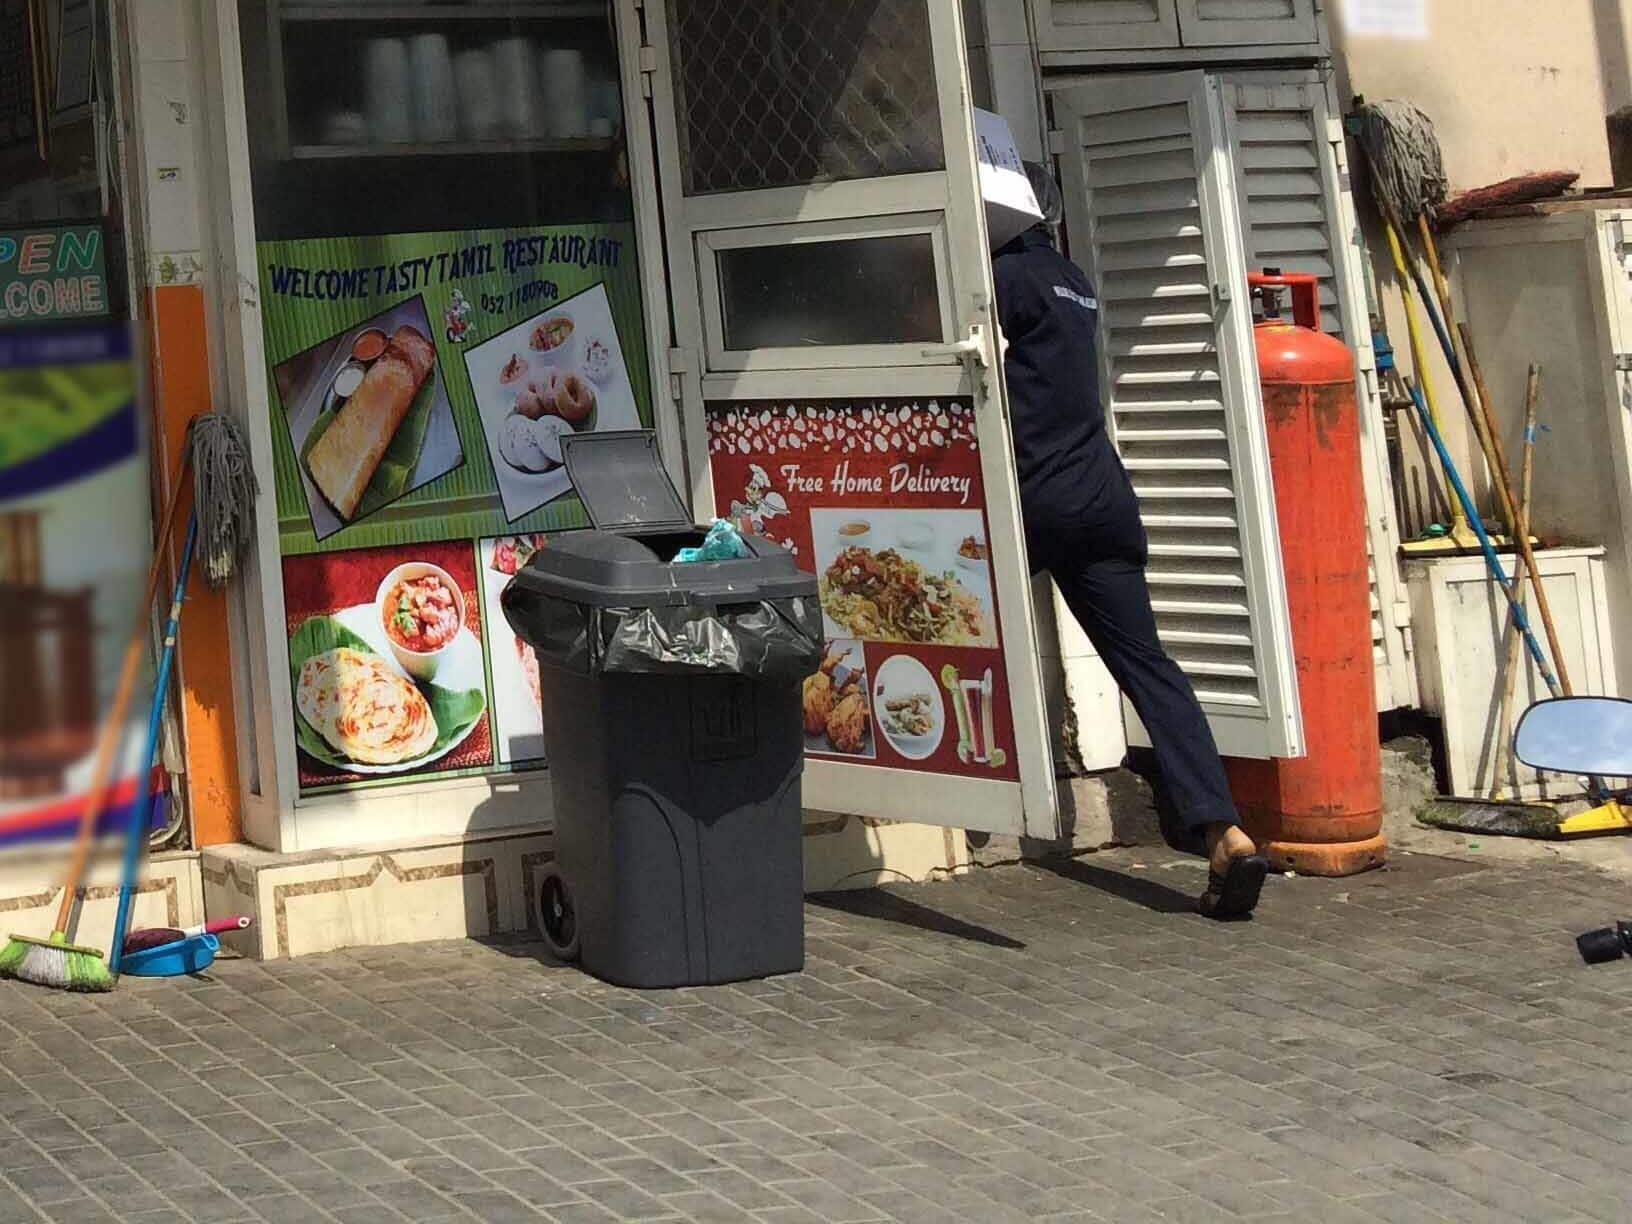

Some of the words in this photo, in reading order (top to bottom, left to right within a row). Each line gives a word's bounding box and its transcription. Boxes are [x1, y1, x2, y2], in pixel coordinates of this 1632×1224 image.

[268, 263, 369, 301] WELCOME
[373, 254, 435, 296] TASTY
[436, 242, 497, 284] TAMIL
[501, 232, 623, 275] RESTAURANT
[779, 463, 824, 494] Free
[830, 461, 883, 495] Home
[889, 463, 971, 504] Delivery
